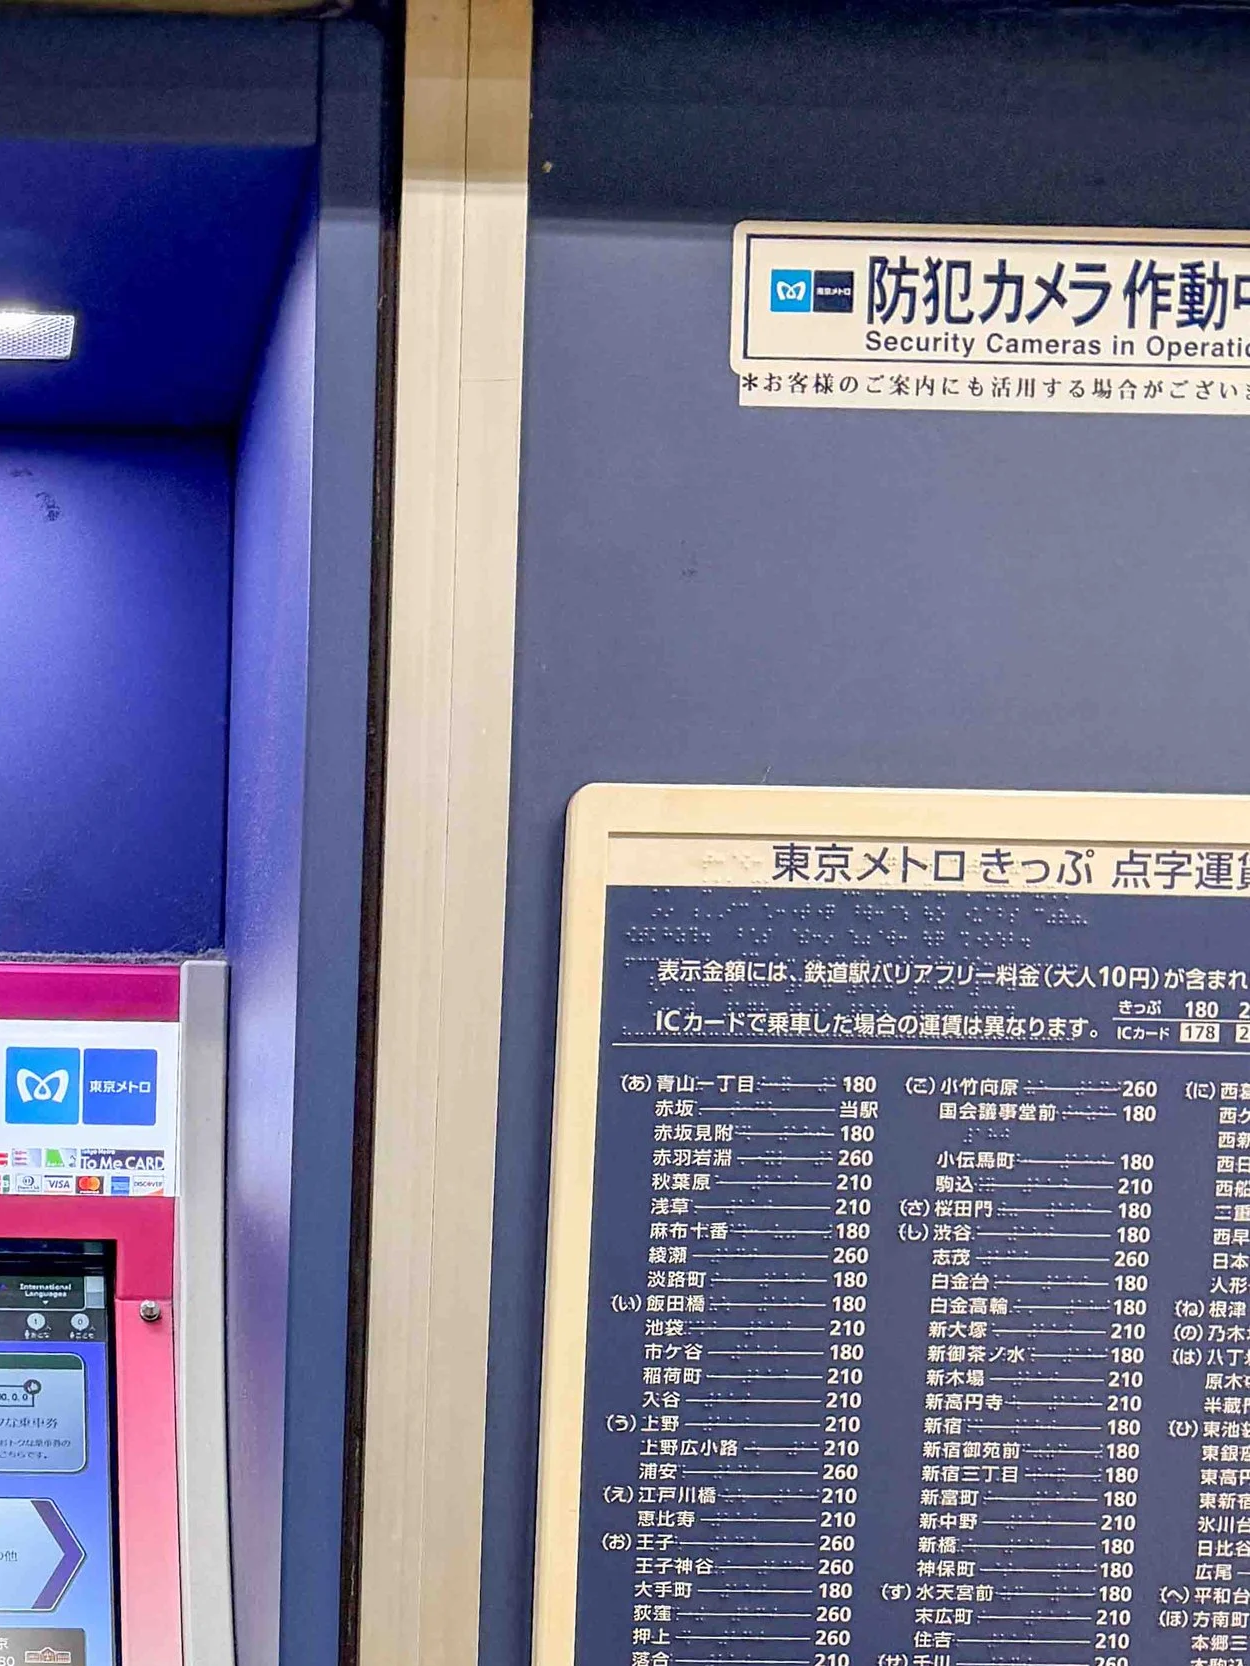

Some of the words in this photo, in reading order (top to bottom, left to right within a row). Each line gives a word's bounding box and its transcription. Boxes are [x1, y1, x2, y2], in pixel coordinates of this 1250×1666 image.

[866, 331, 975, 358] Security
[986, 333, 1102, 356] Cameras
[1113, 335, 1134, 356] in
[1112, 849, 1250, 890] 点字運
[1118, 999, 1162, 1015] きっぷ
[1185, 1000, 1219, 1018] 180
[1116, 1026, 1170, 1041] ICカード
[1185, 1025, 1215, 1041] 178
[89, 1080, 151, 1094] 東京メトロ
[657, 1075, 753, 1093] 青山一丁目
[843, 1077, 877, 1093] 180
[940, 1078, 1019, 1096] 小竹向原
[1122, 1081, 1158, 1097] 260
[655, 1100, 693, 1117] 赤坂
[839, 1101, 878, 1119] 当駅
[654, 1124, 734, 1142] 赤坂見附
[840, 1126, 874, 1142] 180
[82, 1156, 95, 1169] To
[100, 1157, 122, 1169] Me
[125, 1156, 165, 1170] CARD
[48, 1180, 70, 1189] VISA
[651, 1172, 711, 1190] 秋葉原
[836, 1174, 872, 1190] 210
[933, 1224, 971, 1242] 渋谷
[1116, 1227, 1150, 1243] 180
[20, 1283, 71, 1291] International
[25, 1291, 67, 1299] Languages
[646, 1294, 705, 1312] 飯田橋
[832, 1296, 866, 1312] 180
[1209, 1299, 1246, 1318] 根津
[645, 1318, 683, 1336] 池袋
[829, 1320, 865, 1336] 210
[923, 1417, 962, 1435] 新宿
[1107, 1420, 1140, 1436] 180
[918, 1536, 957, 1554] 新橋
[1100, 1539, 1135, 1554] 180
[1195, 1564, 1232, 1581] 広尾
[634, 1580, 692, 1598] 大手町
[818, 1583, 852, 1599] 180
